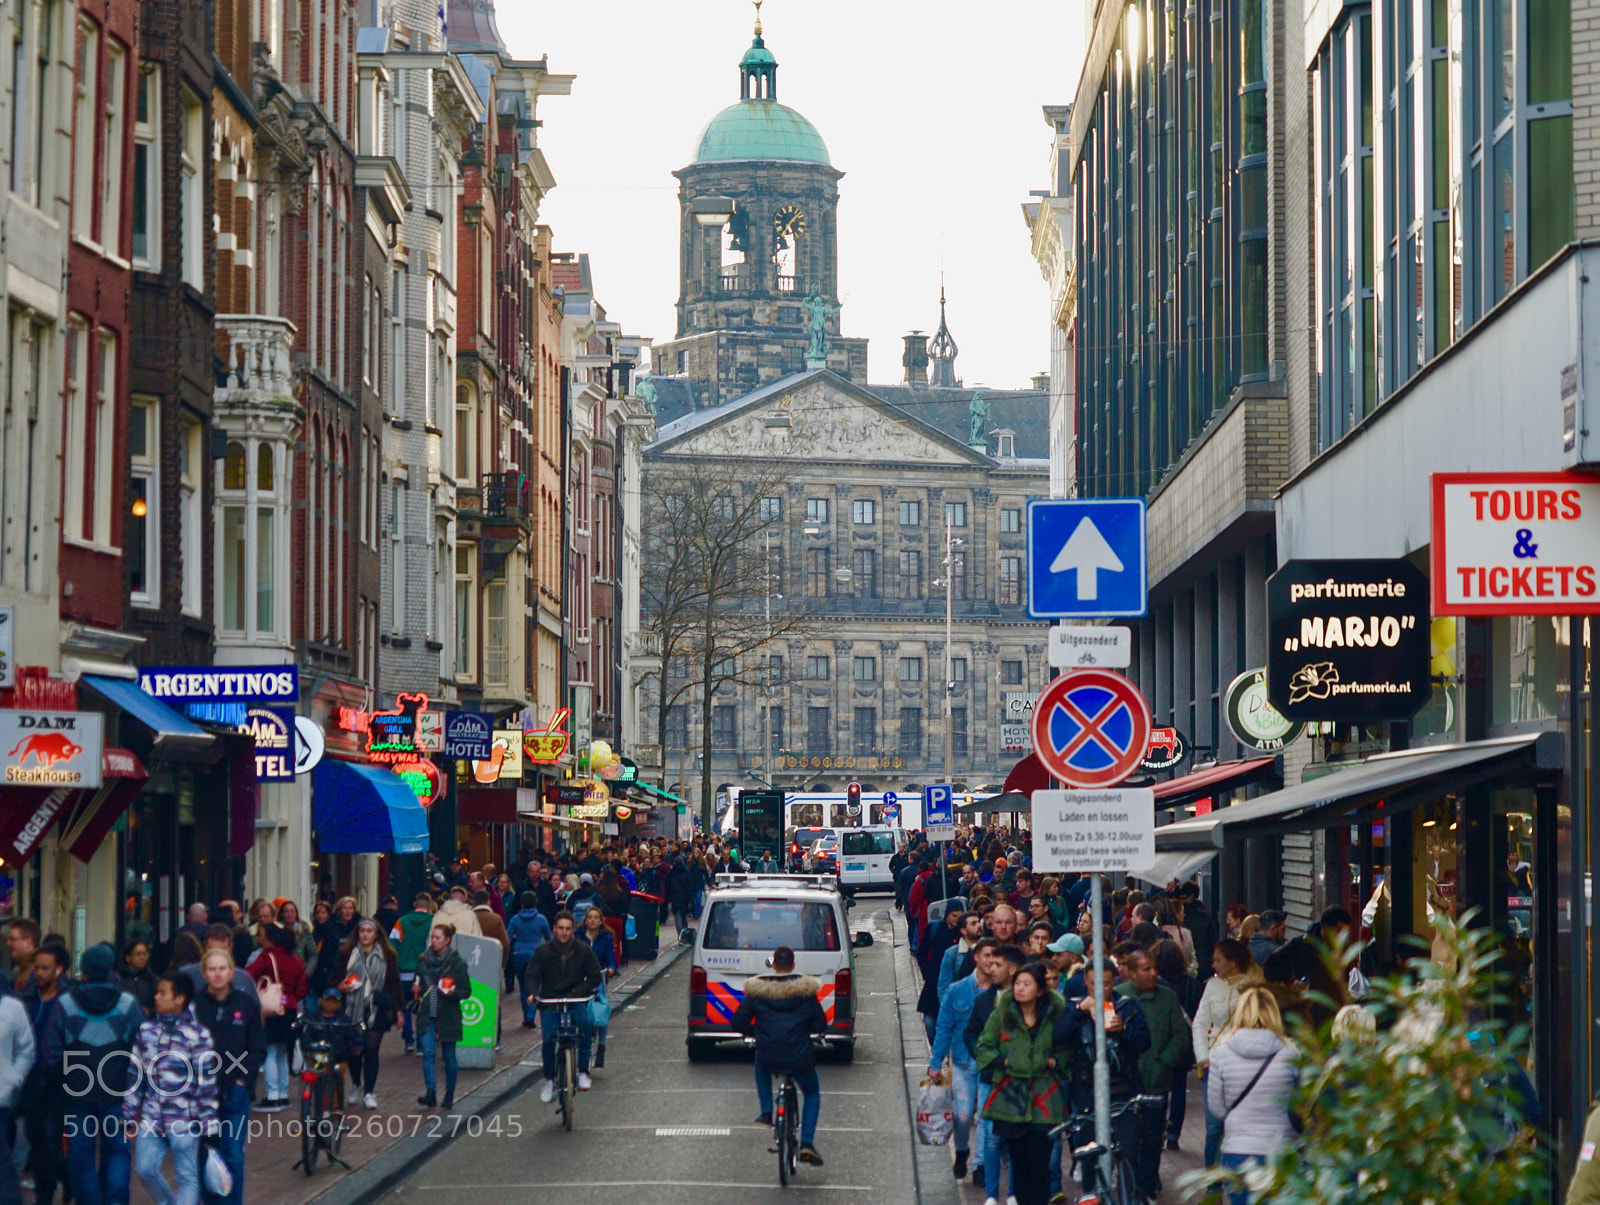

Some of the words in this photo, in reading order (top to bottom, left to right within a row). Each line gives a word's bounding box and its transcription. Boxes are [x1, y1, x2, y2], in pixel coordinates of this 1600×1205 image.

[1470, 490, 1582, 521] TOURS
[1513, 528, 1539, 559] &
[1457, 566, 1597, 598] TICKETS
[1290, 578, 1406, 603] parfumerie
[1060, 633, 1119, 648] Uitgezonderd
[140, 672, 294, 697] ARGENTINOS
[1331, 680, 1412, 697] parfumerie.nl
[18, 715, 76, 730] DAM
[375, 715, 413, 725] ARGENTINA
[456, 718, 481, 734] DAM
[384, 725, 404, 734] GRILL
[1003, 726, 1033, 736] HOTE
[255, 739, 274, 748] AAT
[1005, 737, 1033, 746] DOR
[1255, 737, 1284, 750] ATM
[445, 742, 490, 758] HOTEL
[254, 754, 292, 777] TEL
[1140, 752, 1183, 769] l-restaurant
[6, 765, 82, 784] Steakhouse
[931, 788, 946, 809] P
[1064, 793, 1122, 805] Uitgezonderd
[1059, 811, 1086, 823] Laden
[1087, 814, 1099, 822] en
[1100, 810, 1129, 822] lossen
[1045, 832, 1057, 842] Ma
[1074, 831, 1085, 841] Za
[1086, 830, 1144, 842] 9.30-12.00uur
[1051, 846, 1088, 856] Minimaal
[1089, 847, 1110, 855] twee
[1112, 845, 1140, 855] wielen
[1059, 860, 1071, 868] op
[1072, 857, 1101, 867] trottoir
[1103, 857, 1130, 868] graag.
[707, 957, 741, 965] POLITIE
